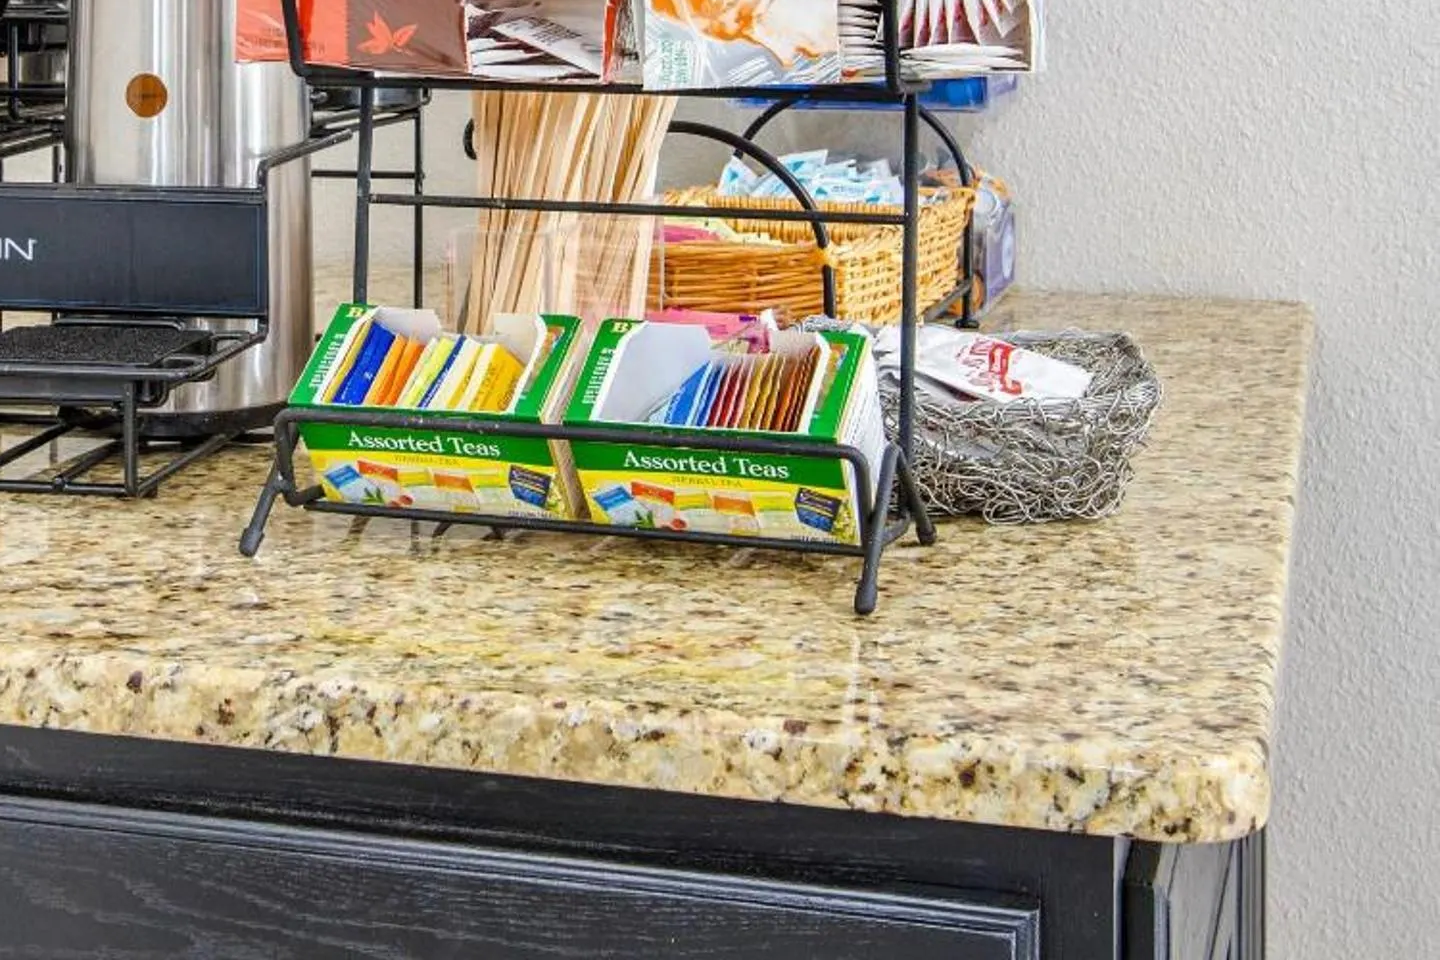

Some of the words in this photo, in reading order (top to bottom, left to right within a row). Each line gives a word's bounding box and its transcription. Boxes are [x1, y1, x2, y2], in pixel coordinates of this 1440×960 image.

[347, 430, 445, 455] Assorted
[447, 436, 501, 458] Teas
[622, 450, 728, 475] Assorted
[732, 457, 790, 479] Teas
